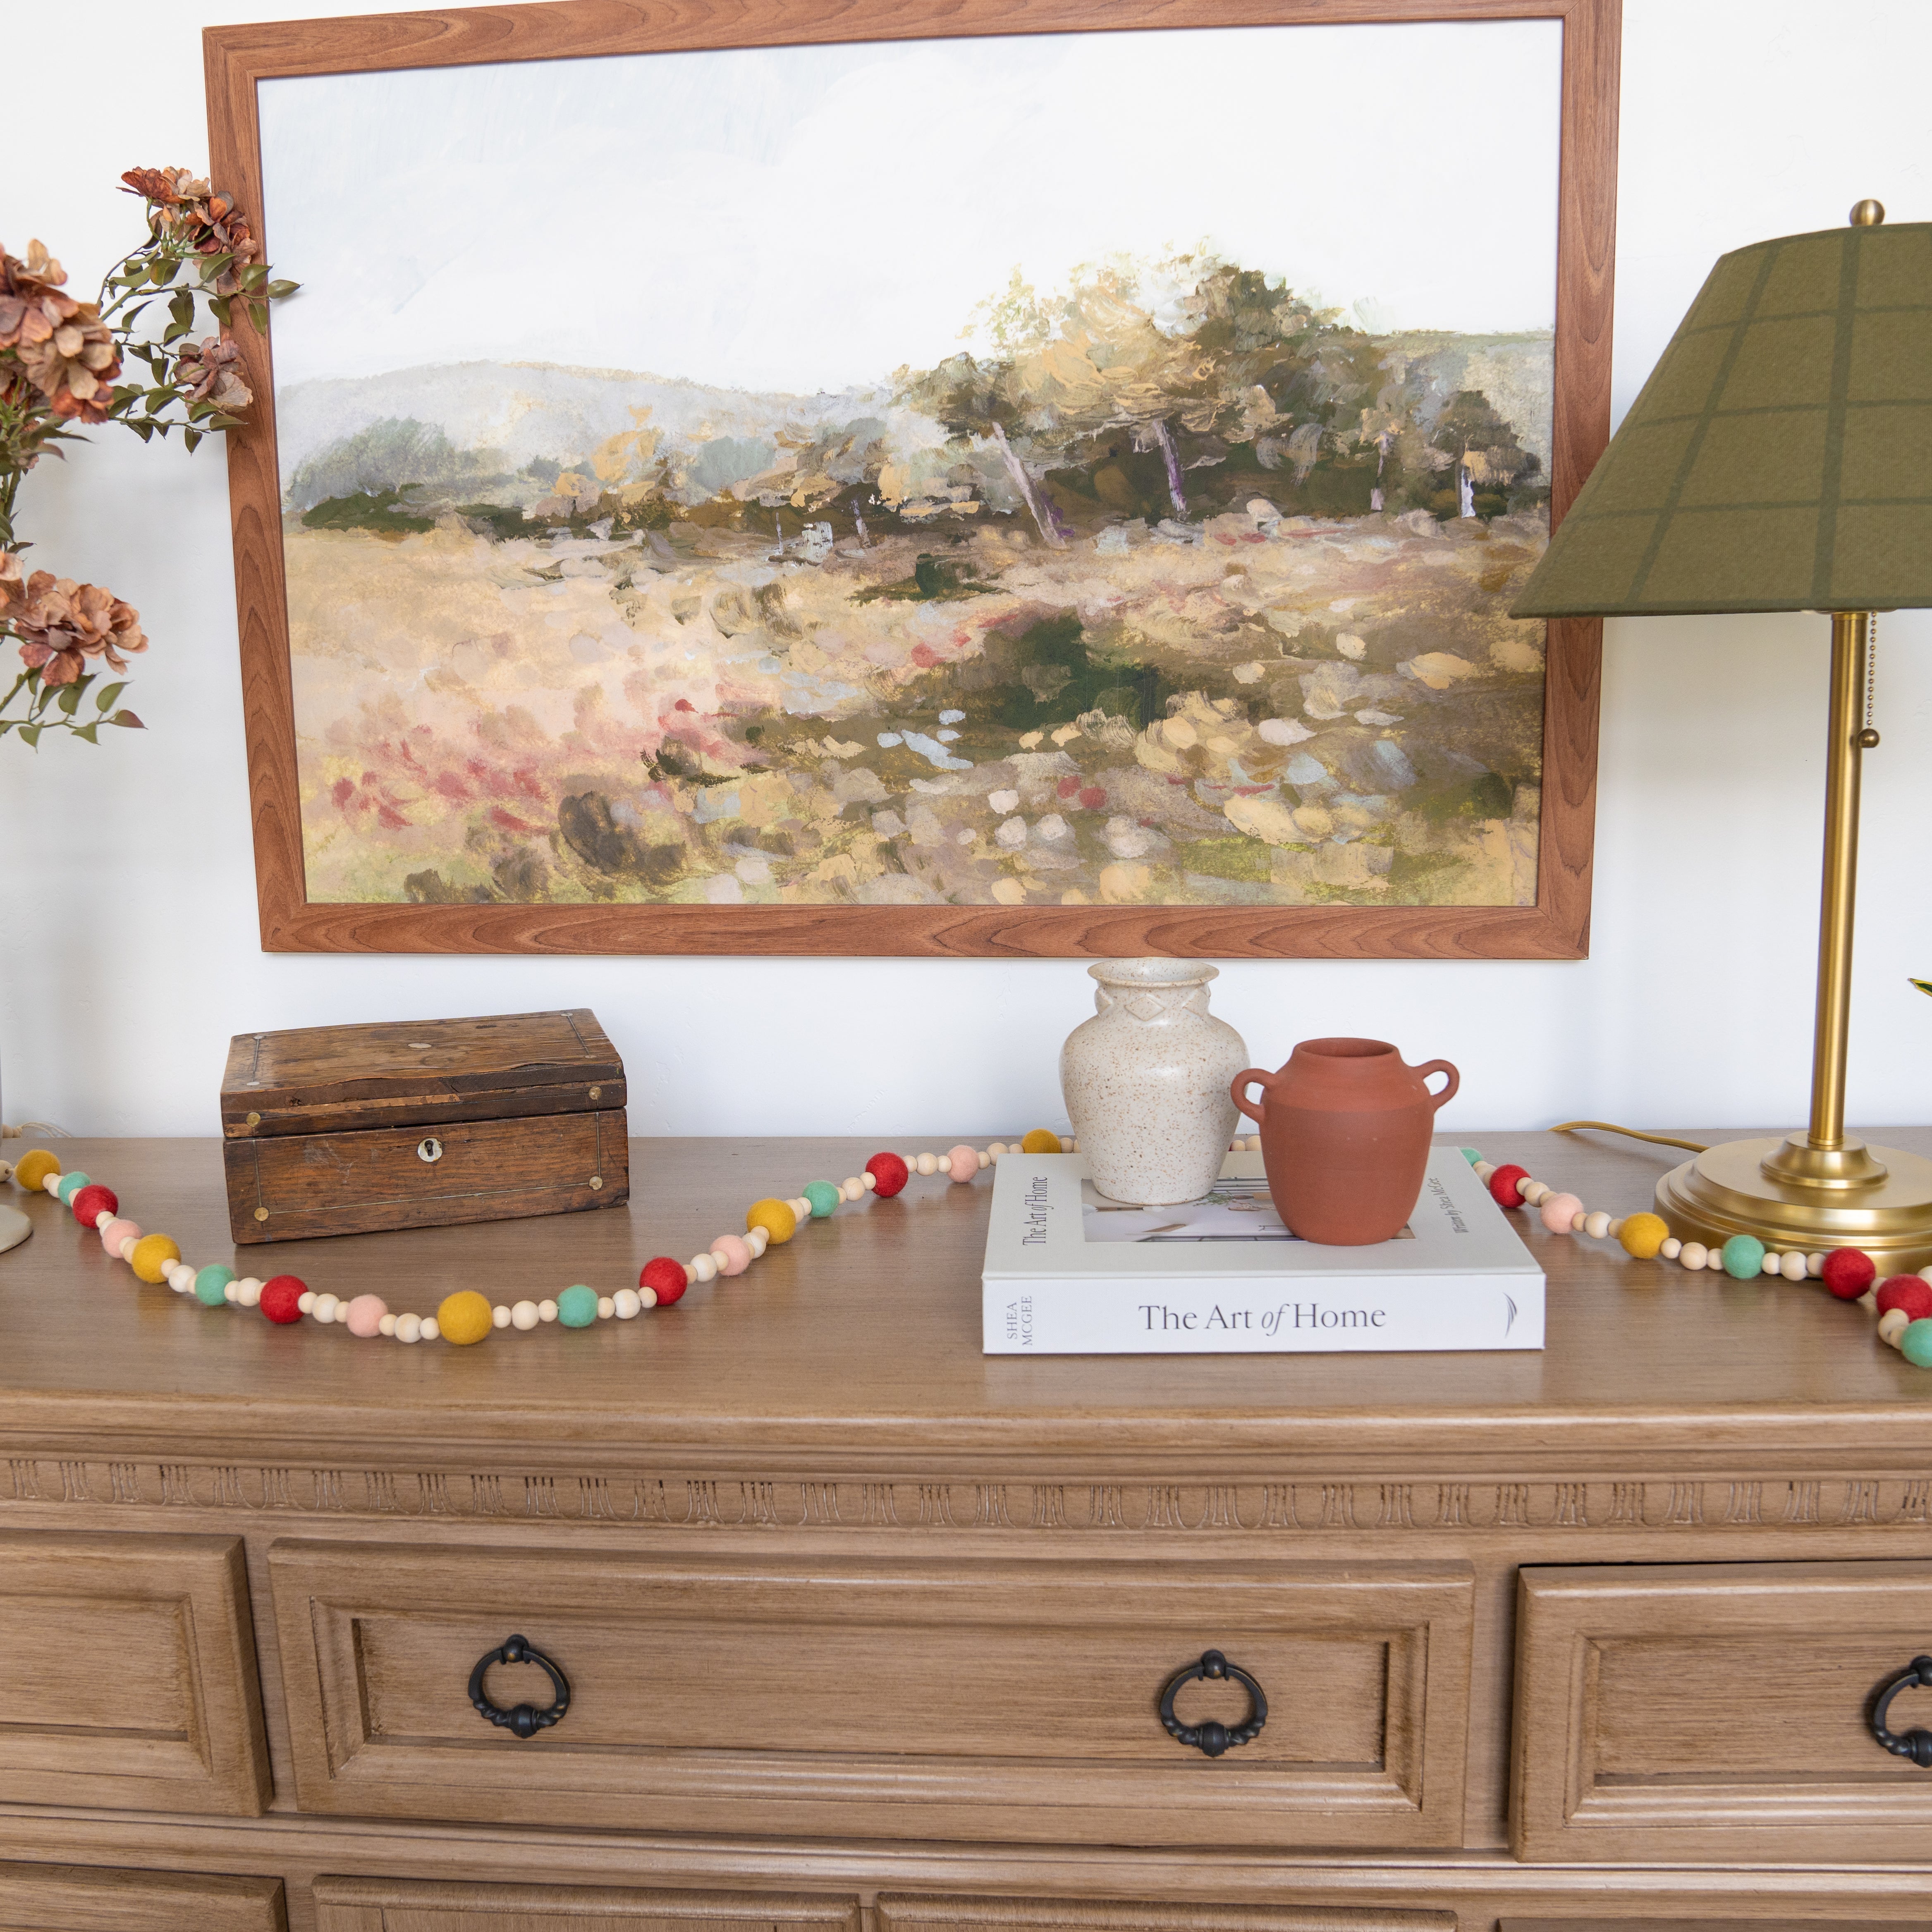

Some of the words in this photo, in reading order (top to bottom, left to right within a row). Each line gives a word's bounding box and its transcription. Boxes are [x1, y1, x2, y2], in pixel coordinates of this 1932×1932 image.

[1025, 1177, 1047, 1202] Home
[1427, 1177, 1447, 1196] McGee
[1025, 1202, 1054, 1211] of
[1439, 1196, 1454, 1209] Shea
[1023, 1212, 1047, 1227] Art
[1451, 1217, 1469, 1233] Written
[1023, 1228, 1046, 1246] The
[1007, 1303, 1017, 1339] SHEA
[1021, 1296, 1032, 1346] MCGEE
[1138, 1305, 1198, 1329] The
[1203, 1304, 1253, 1329] Art
[1261, 1303, 1290, 1337] of
[1292, 1303, 1387, 1328] Home
